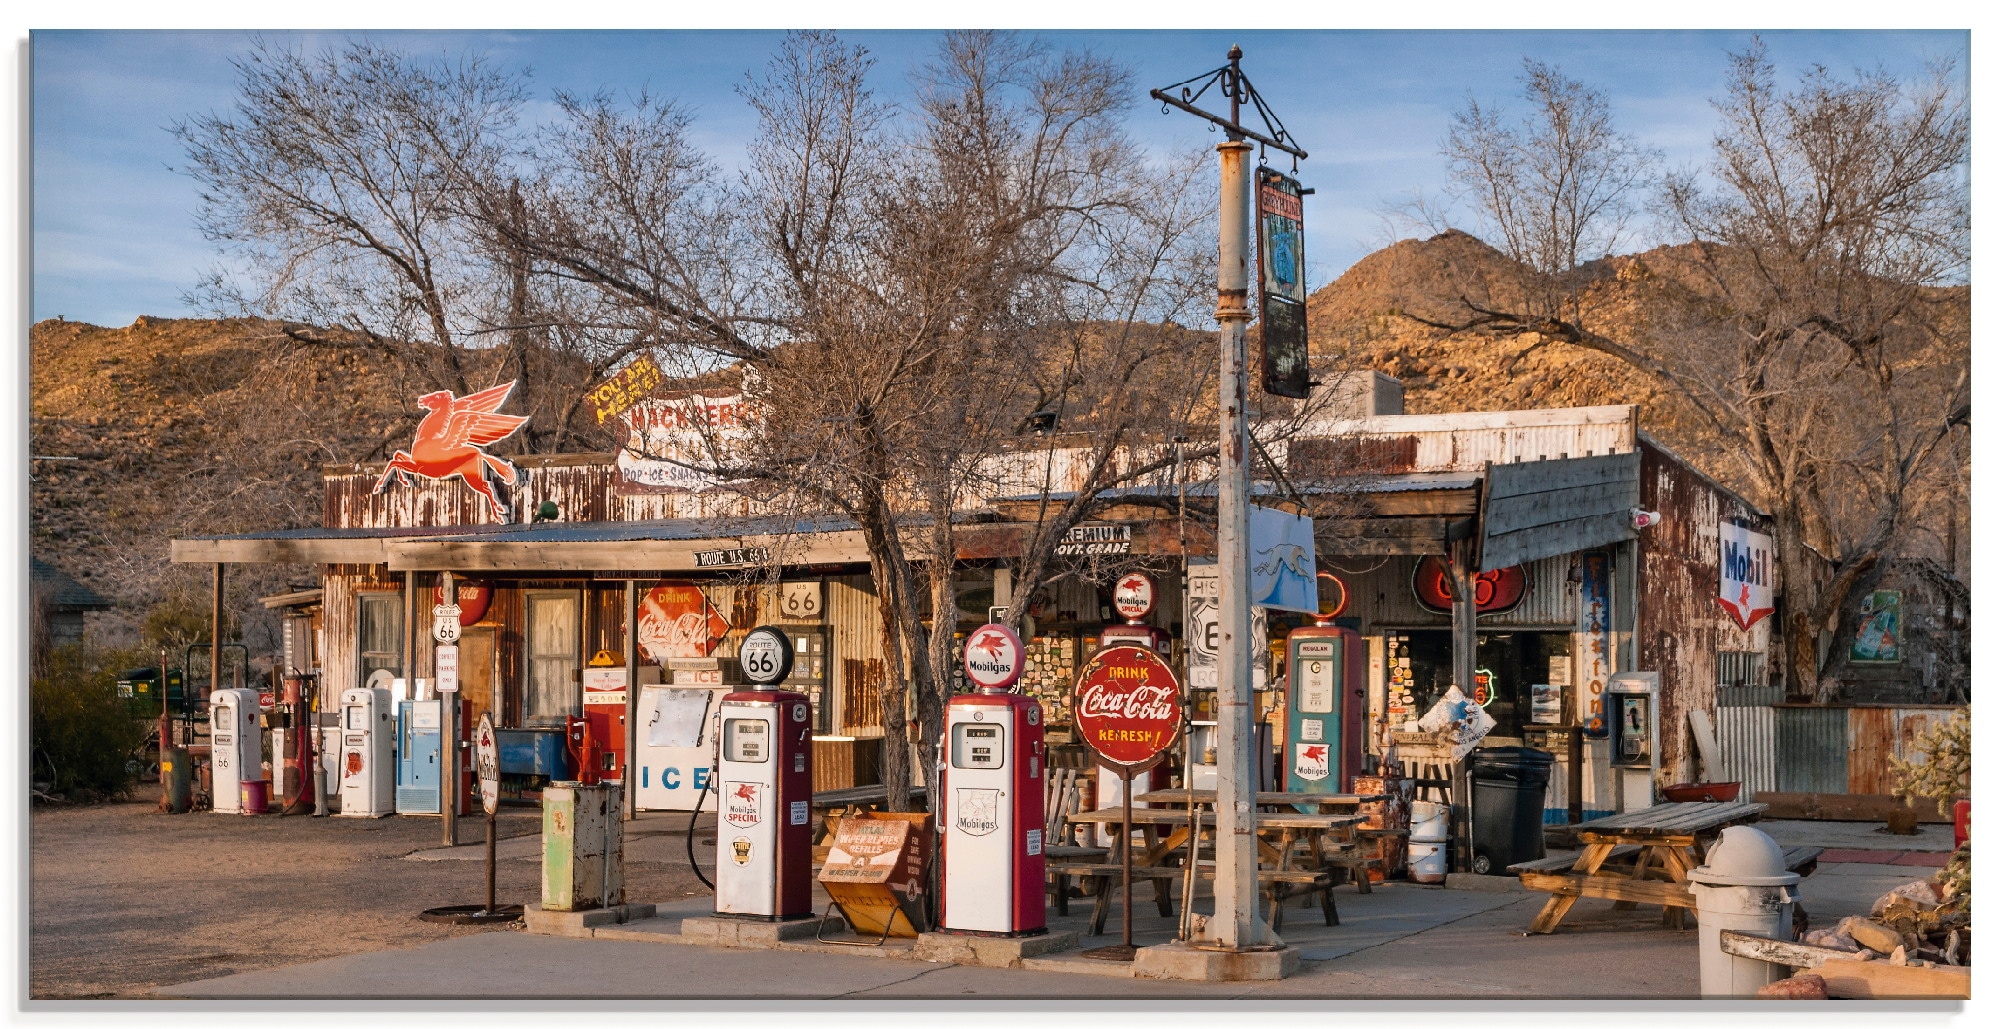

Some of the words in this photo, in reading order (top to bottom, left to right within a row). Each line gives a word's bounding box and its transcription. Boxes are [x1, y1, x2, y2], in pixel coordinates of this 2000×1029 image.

[589, 377, 621, 406] YOU
[623, 468, 642, 482] POP
[1063, 527, 1125, 542] REMIUM
[1086, 543, 1130, 554] GRADE
[701, 551, 726, 566] ROUTE
[730, 549, 747, 563] U.S.
[1725, 540, 1767, 587] Mobil
[659, 592, 691, 603] DRINK
[789, 592, 815, 611] 66
[1117, 597, 1148, 606] Mobilgas
[440, 625, 454, 639] 66
[749, 651, 774, 672] 66
[969, 661, 1011, 674] Mobilgas
[694, 671, 719, 683] ICE
[1109, 667, 1149, 678] DRINK
[1081, 685, 1175, 720] Coca-Cola
[643, 766, 711, 789] ICE
[1298, 766, 1327, 776] Mobilgas
[730, 805, 756, 814] Mobilgas
[728, 813, 758, 822] SPECIAL
[960, 818, 995, 831] Mobilgas
[850, 845, 883, 853] REFILLS
